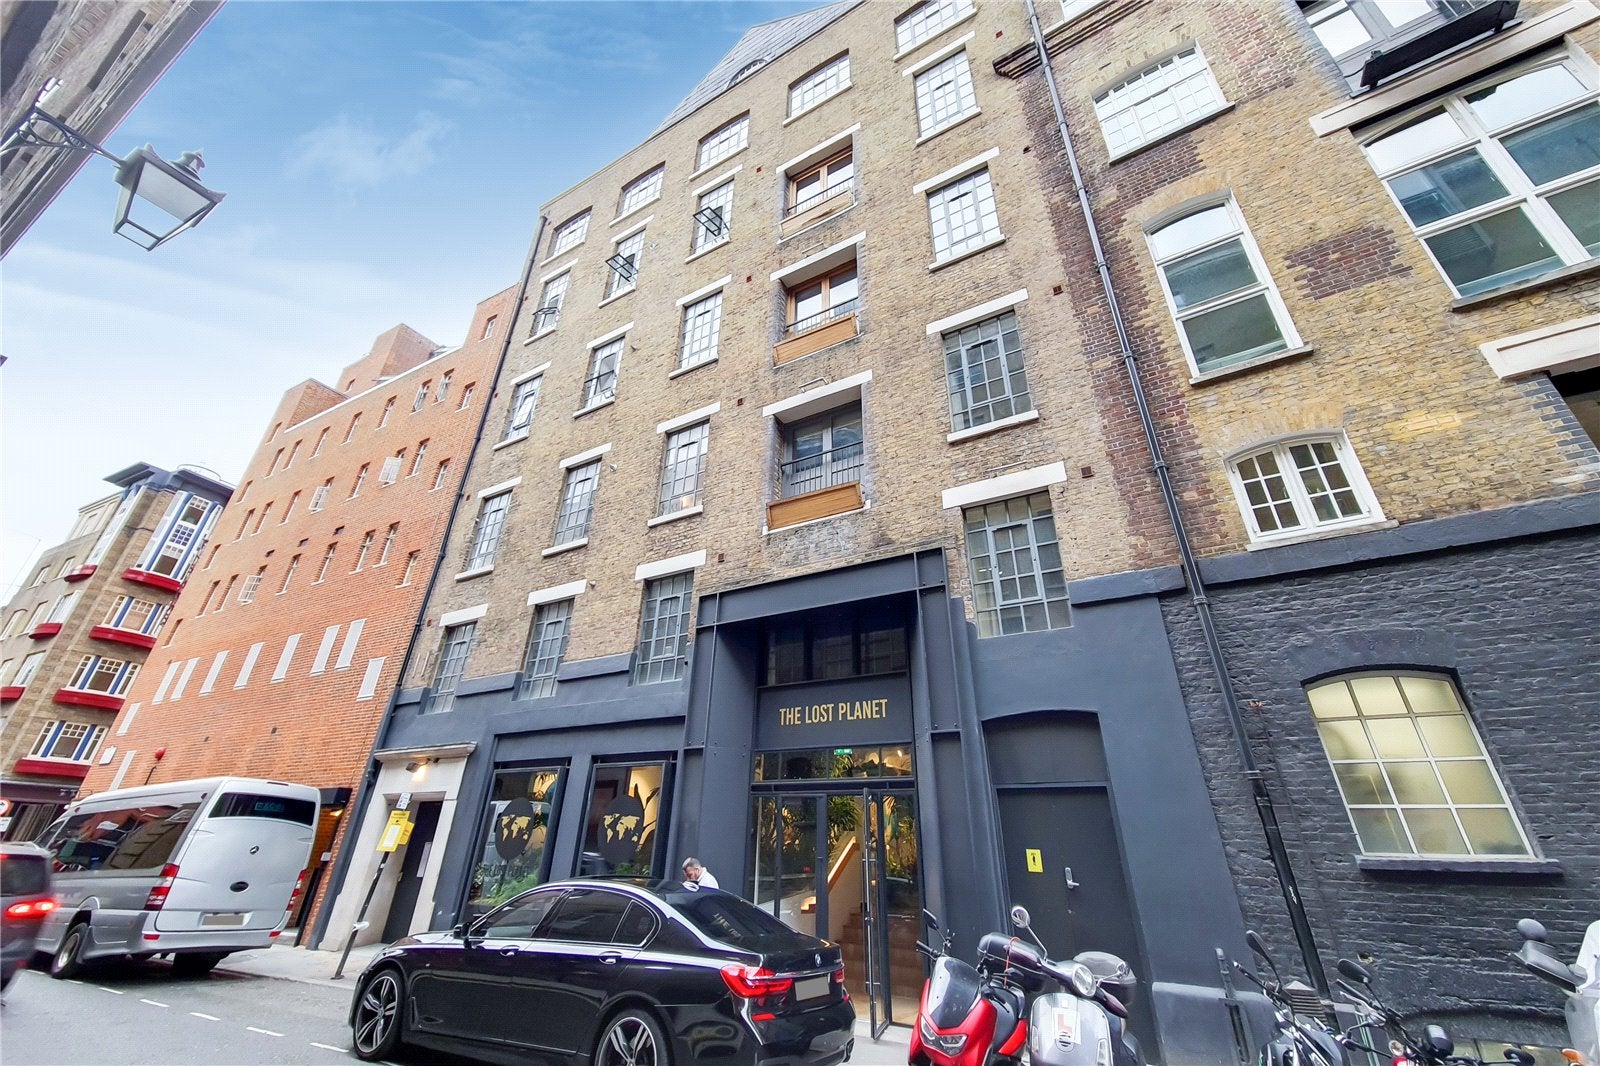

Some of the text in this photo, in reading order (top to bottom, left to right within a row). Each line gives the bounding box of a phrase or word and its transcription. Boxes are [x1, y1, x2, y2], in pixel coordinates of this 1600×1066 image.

[779, 699, 888, 726] THE LOST PLANET
[1057, 1013, 1073, 1034] L
